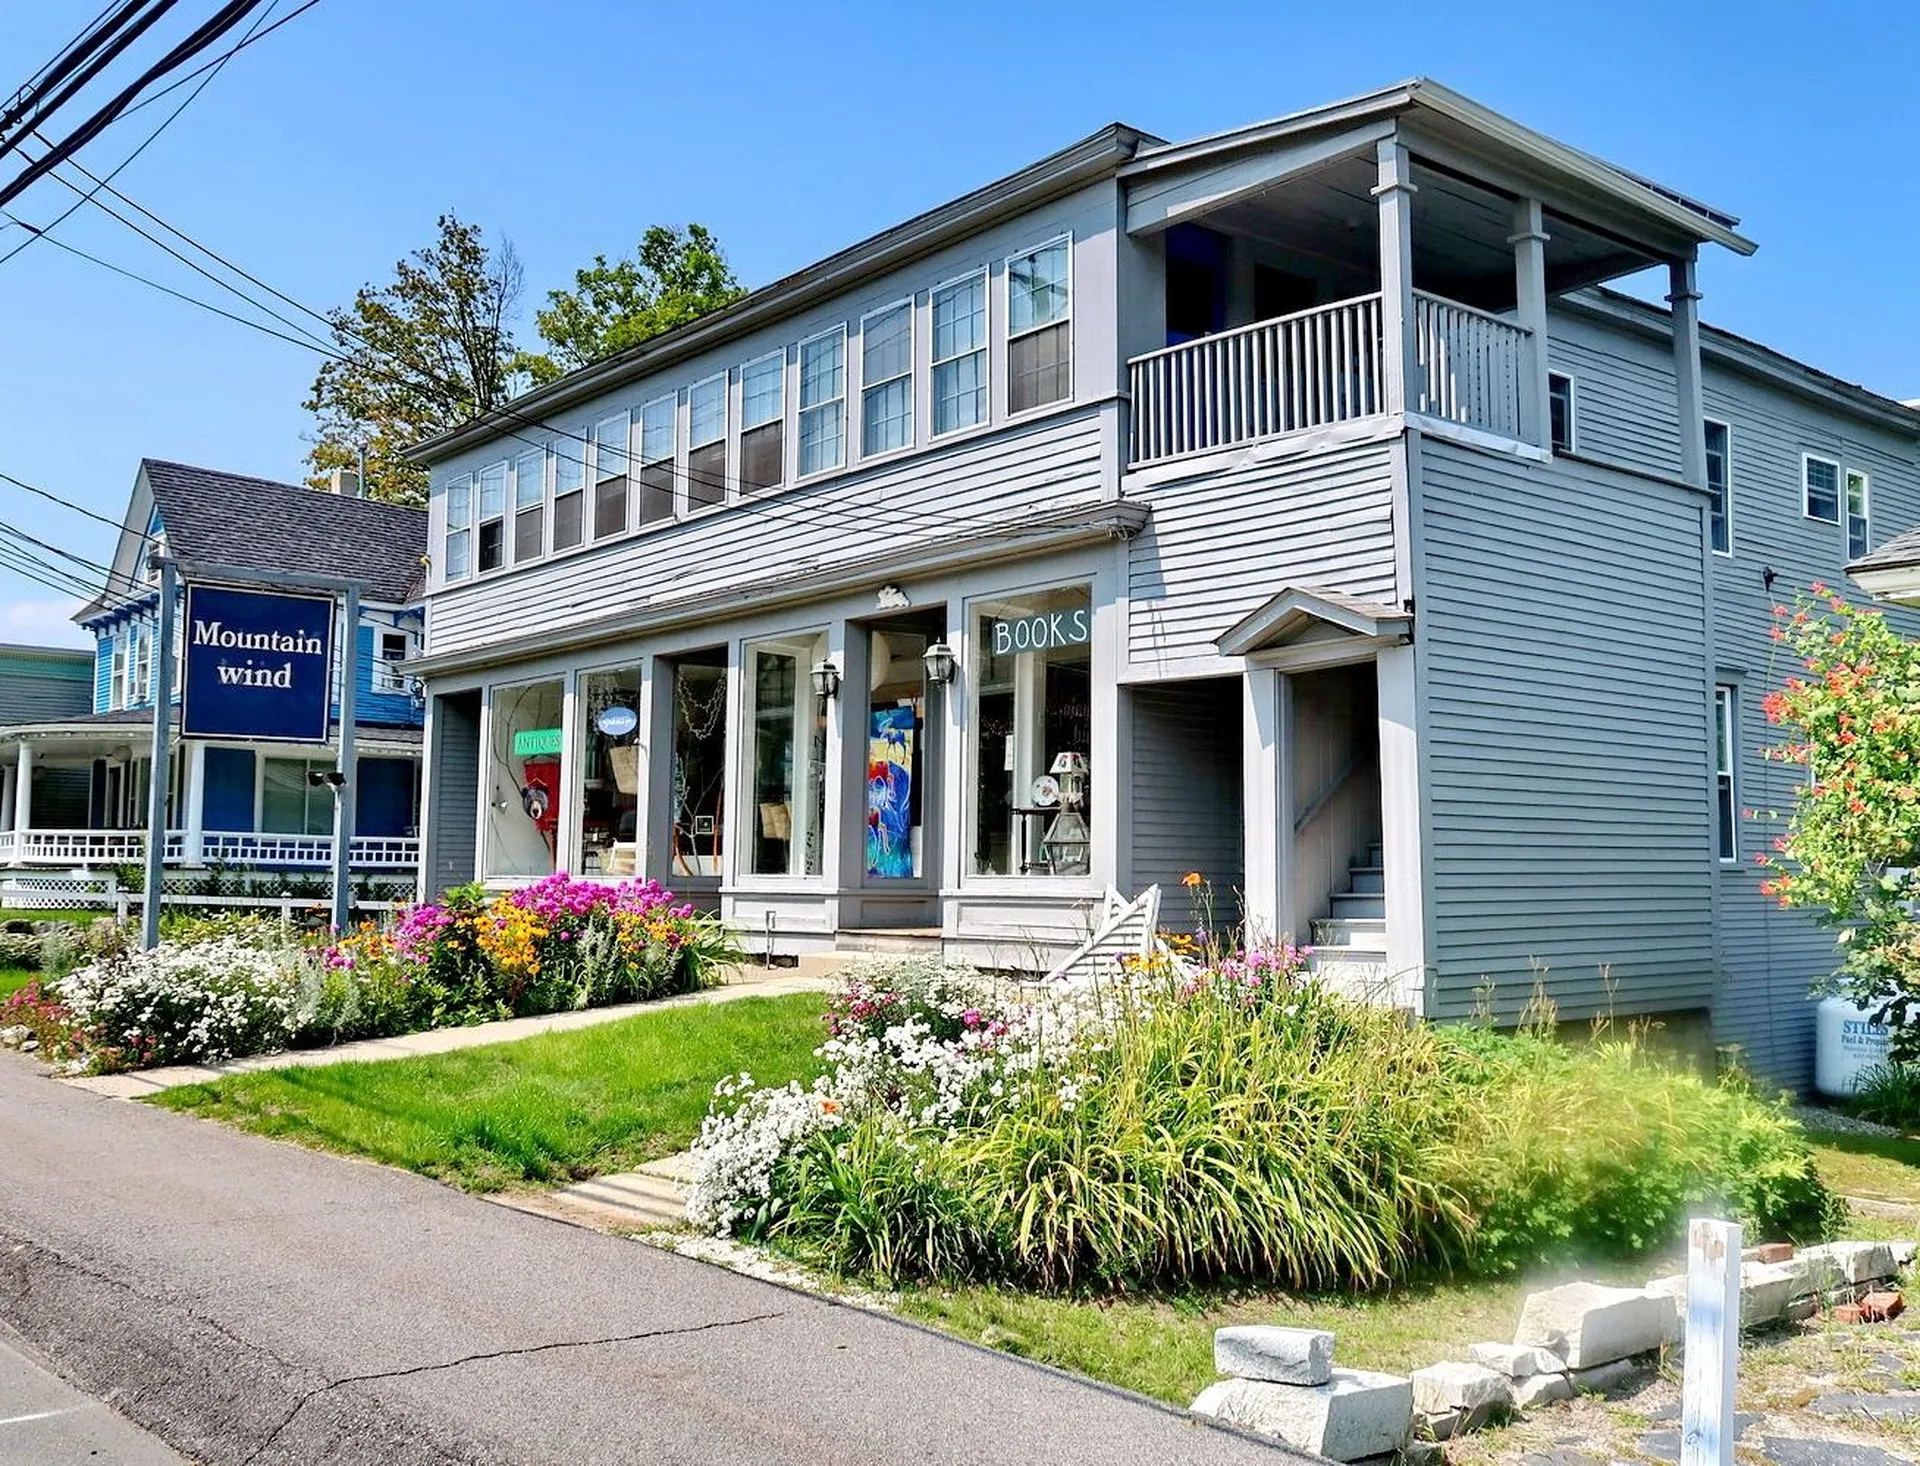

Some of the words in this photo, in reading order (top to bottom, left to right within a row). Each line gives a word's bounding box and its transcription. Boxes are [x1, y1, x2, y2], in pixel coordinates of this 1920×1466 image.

[193, 620, 322, 655] Mountain
[994, 609, 1088, 654] BOOKS
[217, 659, 292, 689] wind
[517, 733, 561, 751] ANTIQUES
